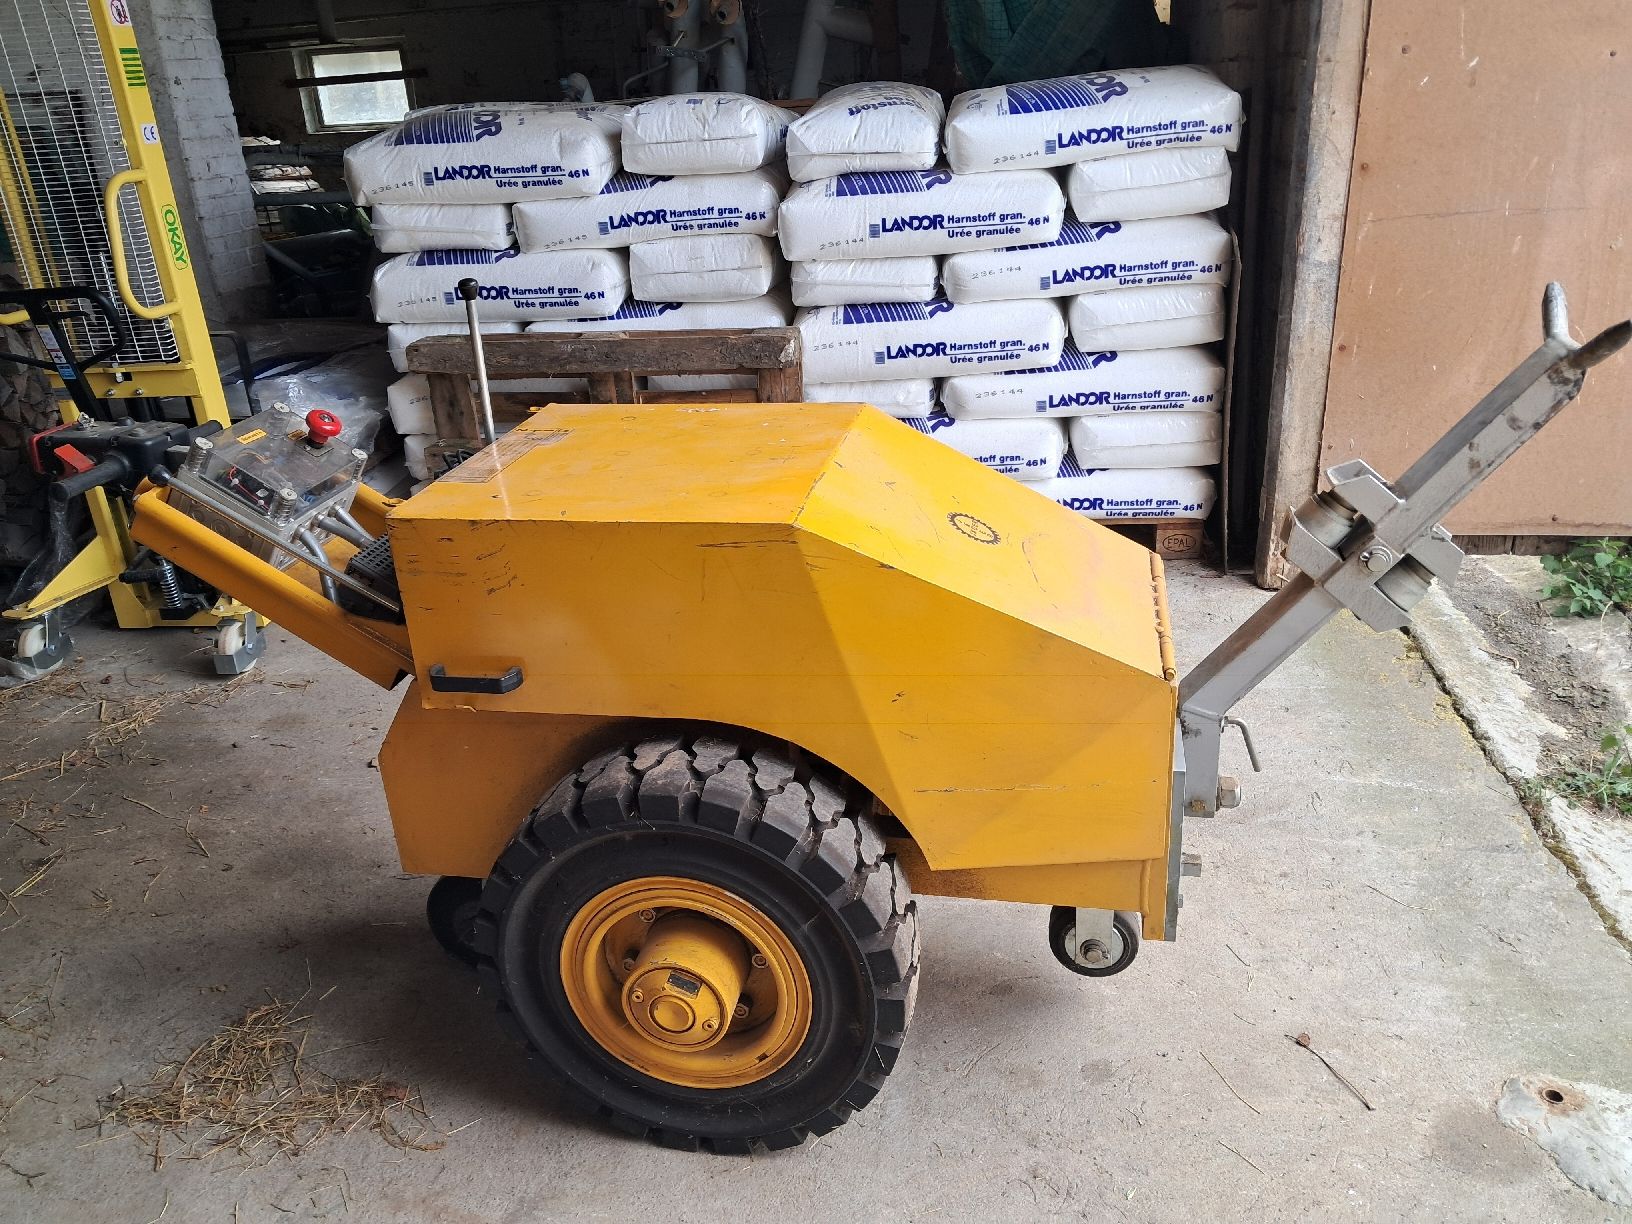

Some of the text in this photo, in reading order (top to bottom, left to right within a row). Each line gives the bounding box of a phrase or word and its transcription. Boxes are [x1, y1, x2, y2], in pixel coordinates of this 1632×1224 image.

[1127, 120, 1209, 135] Harnstoff gran.
[1210, 124, 1233, 134] 46 N
[1058, 126, 1124, 148] LANDOR
[1127, 134, 1202, 149] Urée granulée
[433, 165, 493, 181] LANDOR
[493, 164, 566, 175] Harnstoff gran.
[568, 169, 590, 178] 46 N
[496, 178, 563, 188] Urée granulée
[669, 207, 743, 218] Harnstoff gran.
[745, 212, 757, 221] 46
[947, 211, 1026, 224] Harnstoff gran.
[608, 209, 669, 230] LANDOR
[881, 214, 945, 233] LANDOR
[1028, 215, 1050, 226] 46 N
[671, 220, 739, 231] Urée granulée
[163, 208, 187, 265] OKAY
[947, 226, 1021, 238] Urée granulée
[1119, 260, 1198, 273] Harnstoff gran.
[1200, 263, 1222, 273] 46 N
[1052, 263, 1117, 285] LANDOR
[1119, 273, 1192, 285] Urée granulée
[454, 286, 511, 300] LDOR
[511, 286, 582, 296] Harnstoff gran.
[583, 291, 605, 300] 46 N
[514, 299, 579, 309] Urée granulée
[949, 339, 1026, 351] Harnstoff gran.
[1027, 342, 1050, 353] 46 N
[886, 342, 947, 360] LANDOR
[950, 352, 1021, 364] Urée granulée
[1049, 391, 1111, 409] LANDOR
[1113, 390, 1191, 401] Harnstoff gran.
[1192, 394, 1214, 404] 46 N
[1112, 403, 1136, 412] Urée
[999, 455, 1024, 463] gran.
[1025, 457, 1047, 467] 46 N
[1056, 497, 1105, 511] NDOR
[1106, 498, 1181, 508] Harnstoff gran.
[1196, 502, 1203, 510] N
[1132, 510, 1175, 518] granulée
[1167, 538, 1192, 549] EPAL
